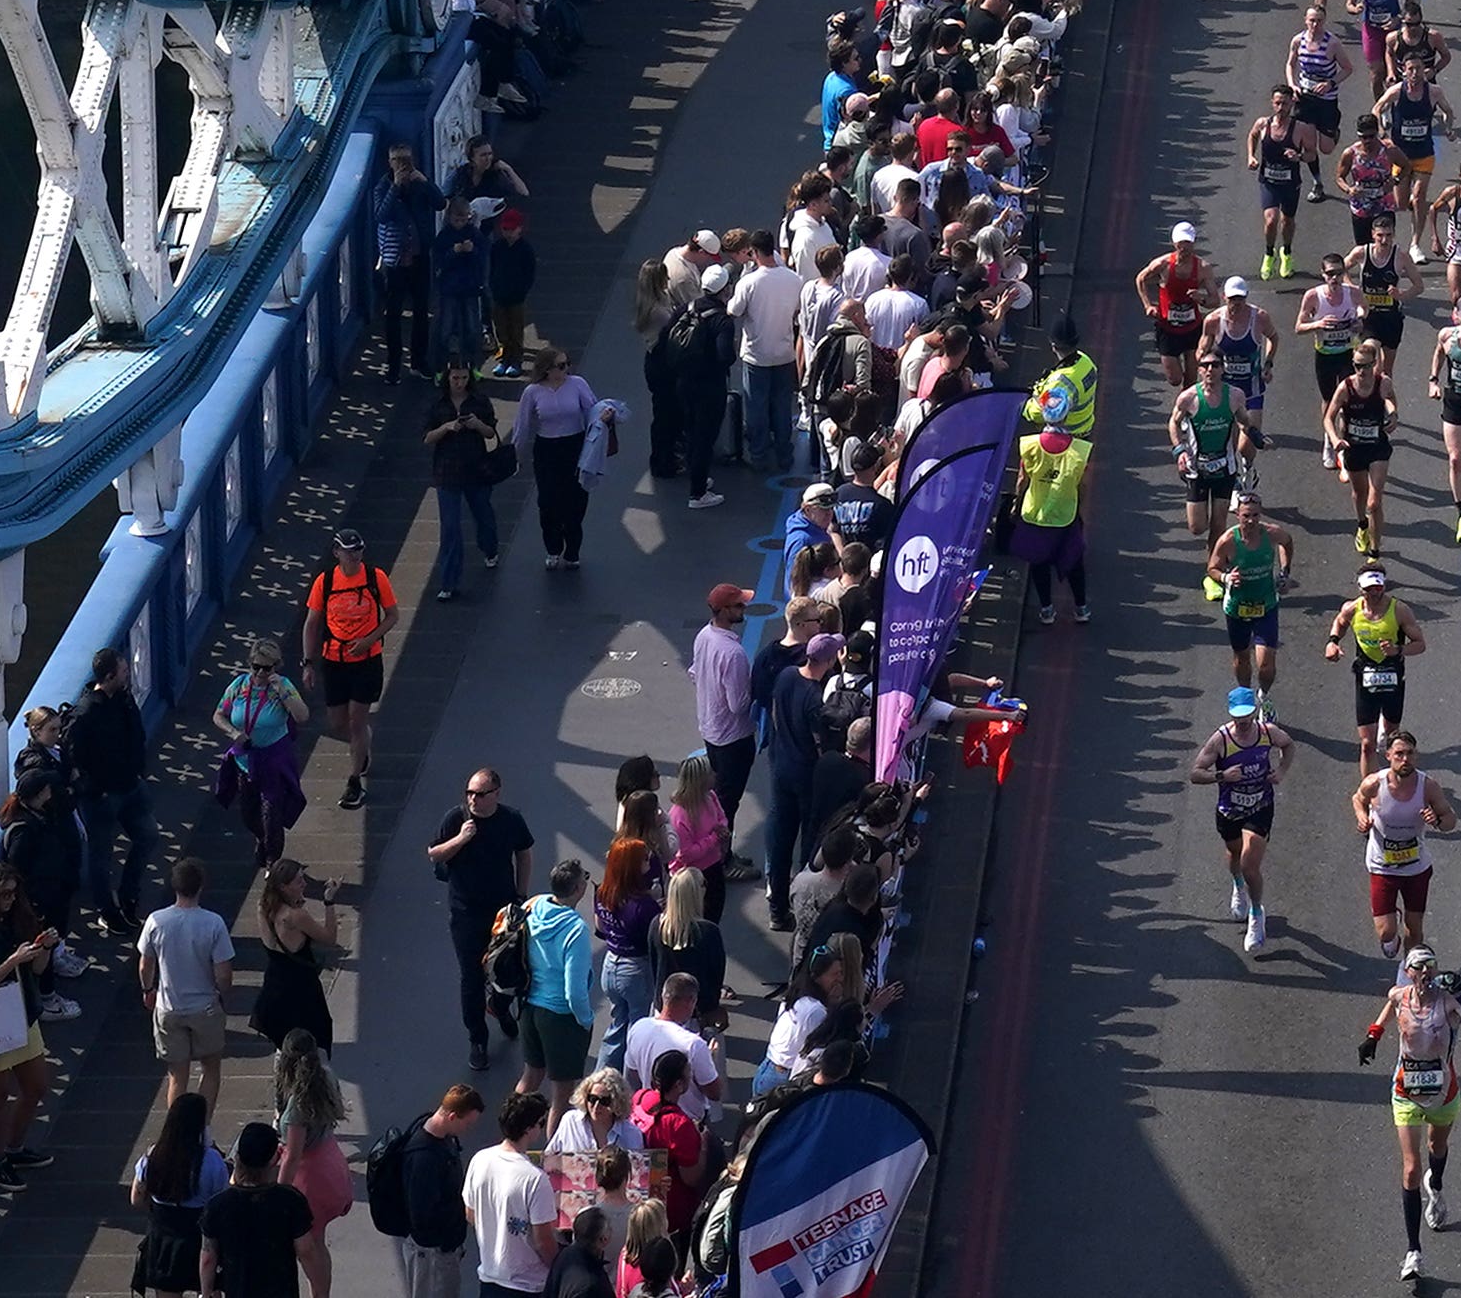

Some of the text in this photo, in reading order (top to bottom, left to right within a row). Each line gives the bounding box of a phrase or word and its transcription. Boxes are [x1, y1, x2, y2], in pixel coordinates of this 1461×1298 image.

[901, 552, 931, 577] hft
[795, 1190, 886, 1247] TEENAGE
[808, 1213, 885, 1263] CANCER
[816, 1241, 872, 1281] TRUST
